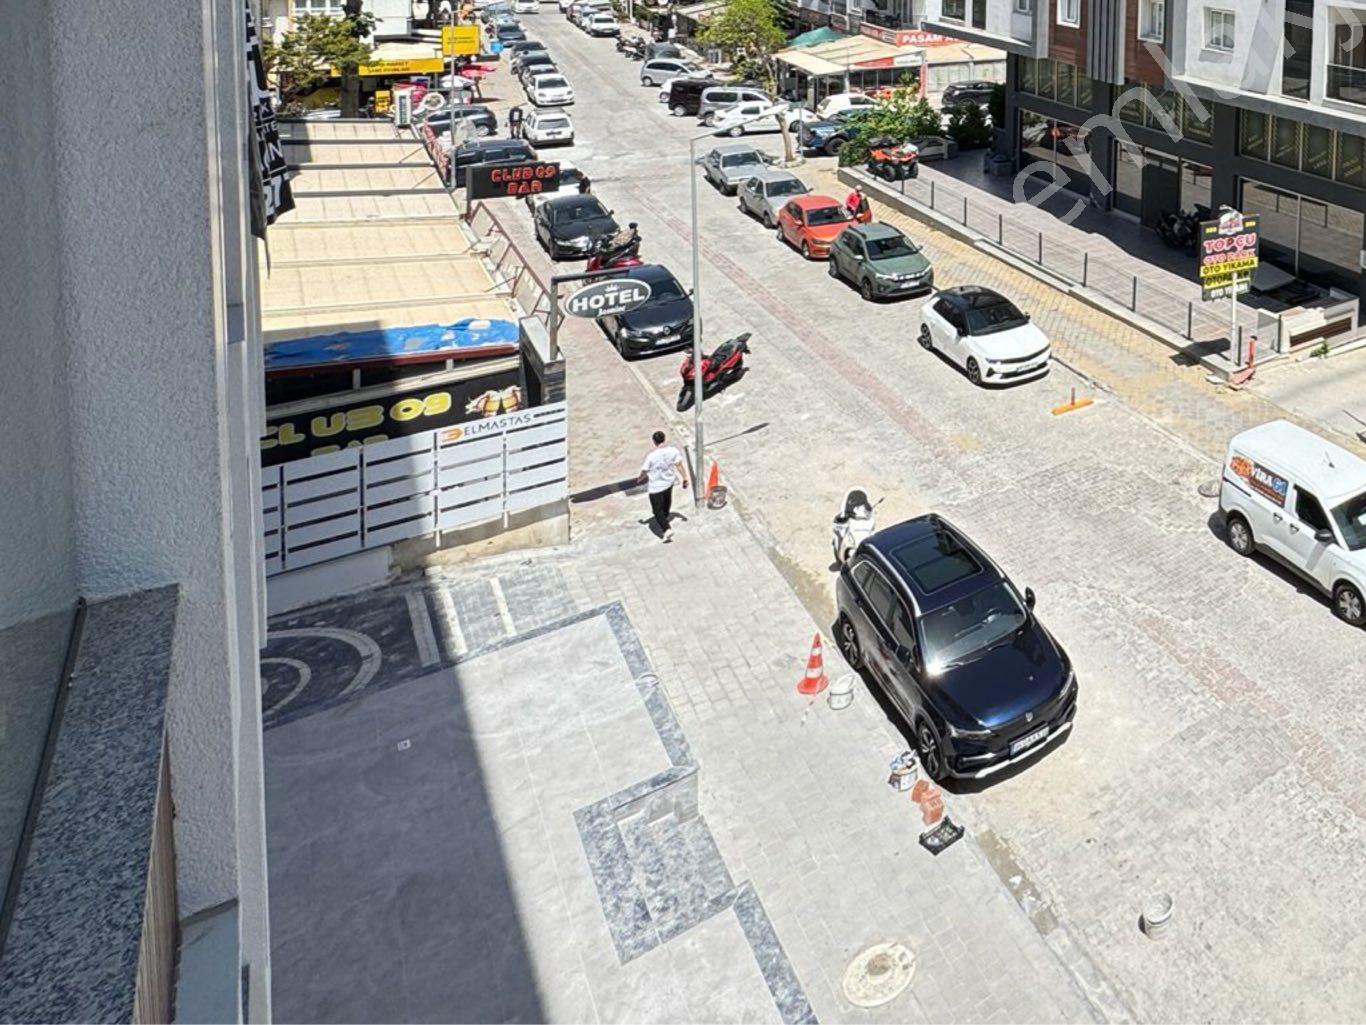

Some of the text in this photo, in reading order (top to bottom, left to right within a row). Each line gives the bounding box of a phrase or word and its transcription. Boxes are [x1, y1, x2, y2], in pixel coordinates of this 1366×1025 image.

[491, 167, 534, 182] CLUB
[507, 180, 543, 194] BAR
[1203, 259, 1255, 274] OTO YIKAMA
[572, 288, 646, 312] HOTEL
